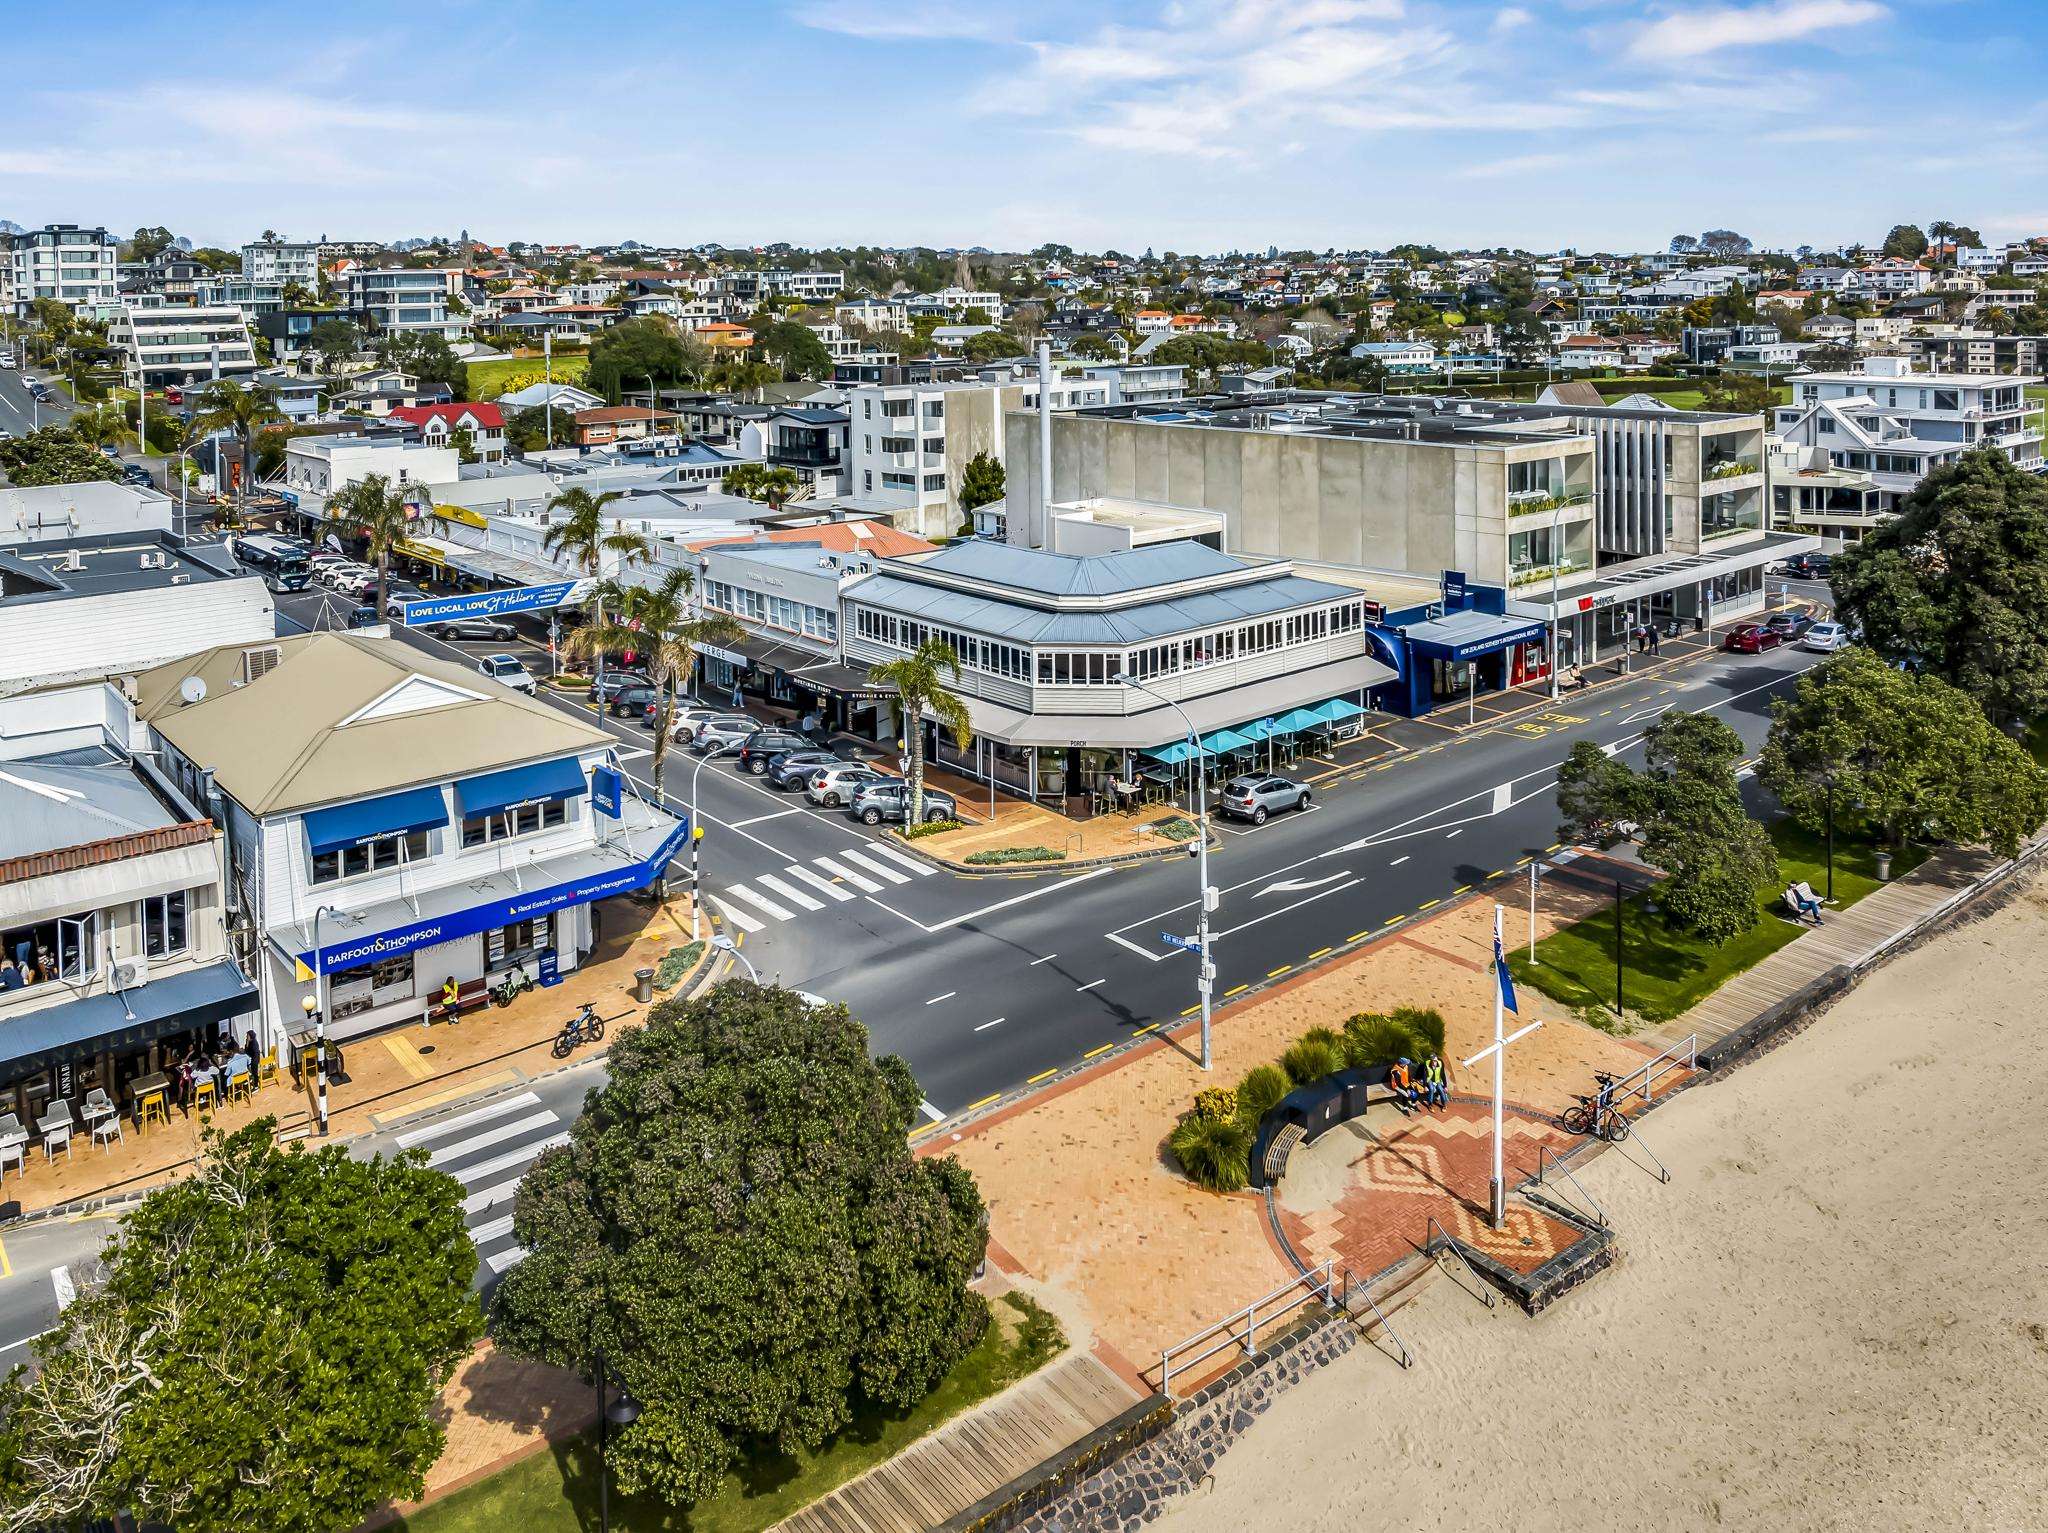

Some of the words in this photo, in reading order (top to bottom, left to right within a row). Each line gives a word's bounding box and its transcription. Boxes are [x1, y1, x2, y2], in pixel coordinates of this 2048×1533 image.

[410, 604, 433, 617] LOVE
[434, 603, 465, 615] LOCAL,
[466, 600, 488, 611] LOVE
[503, 590, 535, 608] Heliers
[518, 904, 532, 913] Real
[532, 899, 550, 910] Estate
[551, 895, 567, 904] Sales
[577, 886, 600, 897] Property
[601, 876, 636, 890] Management
